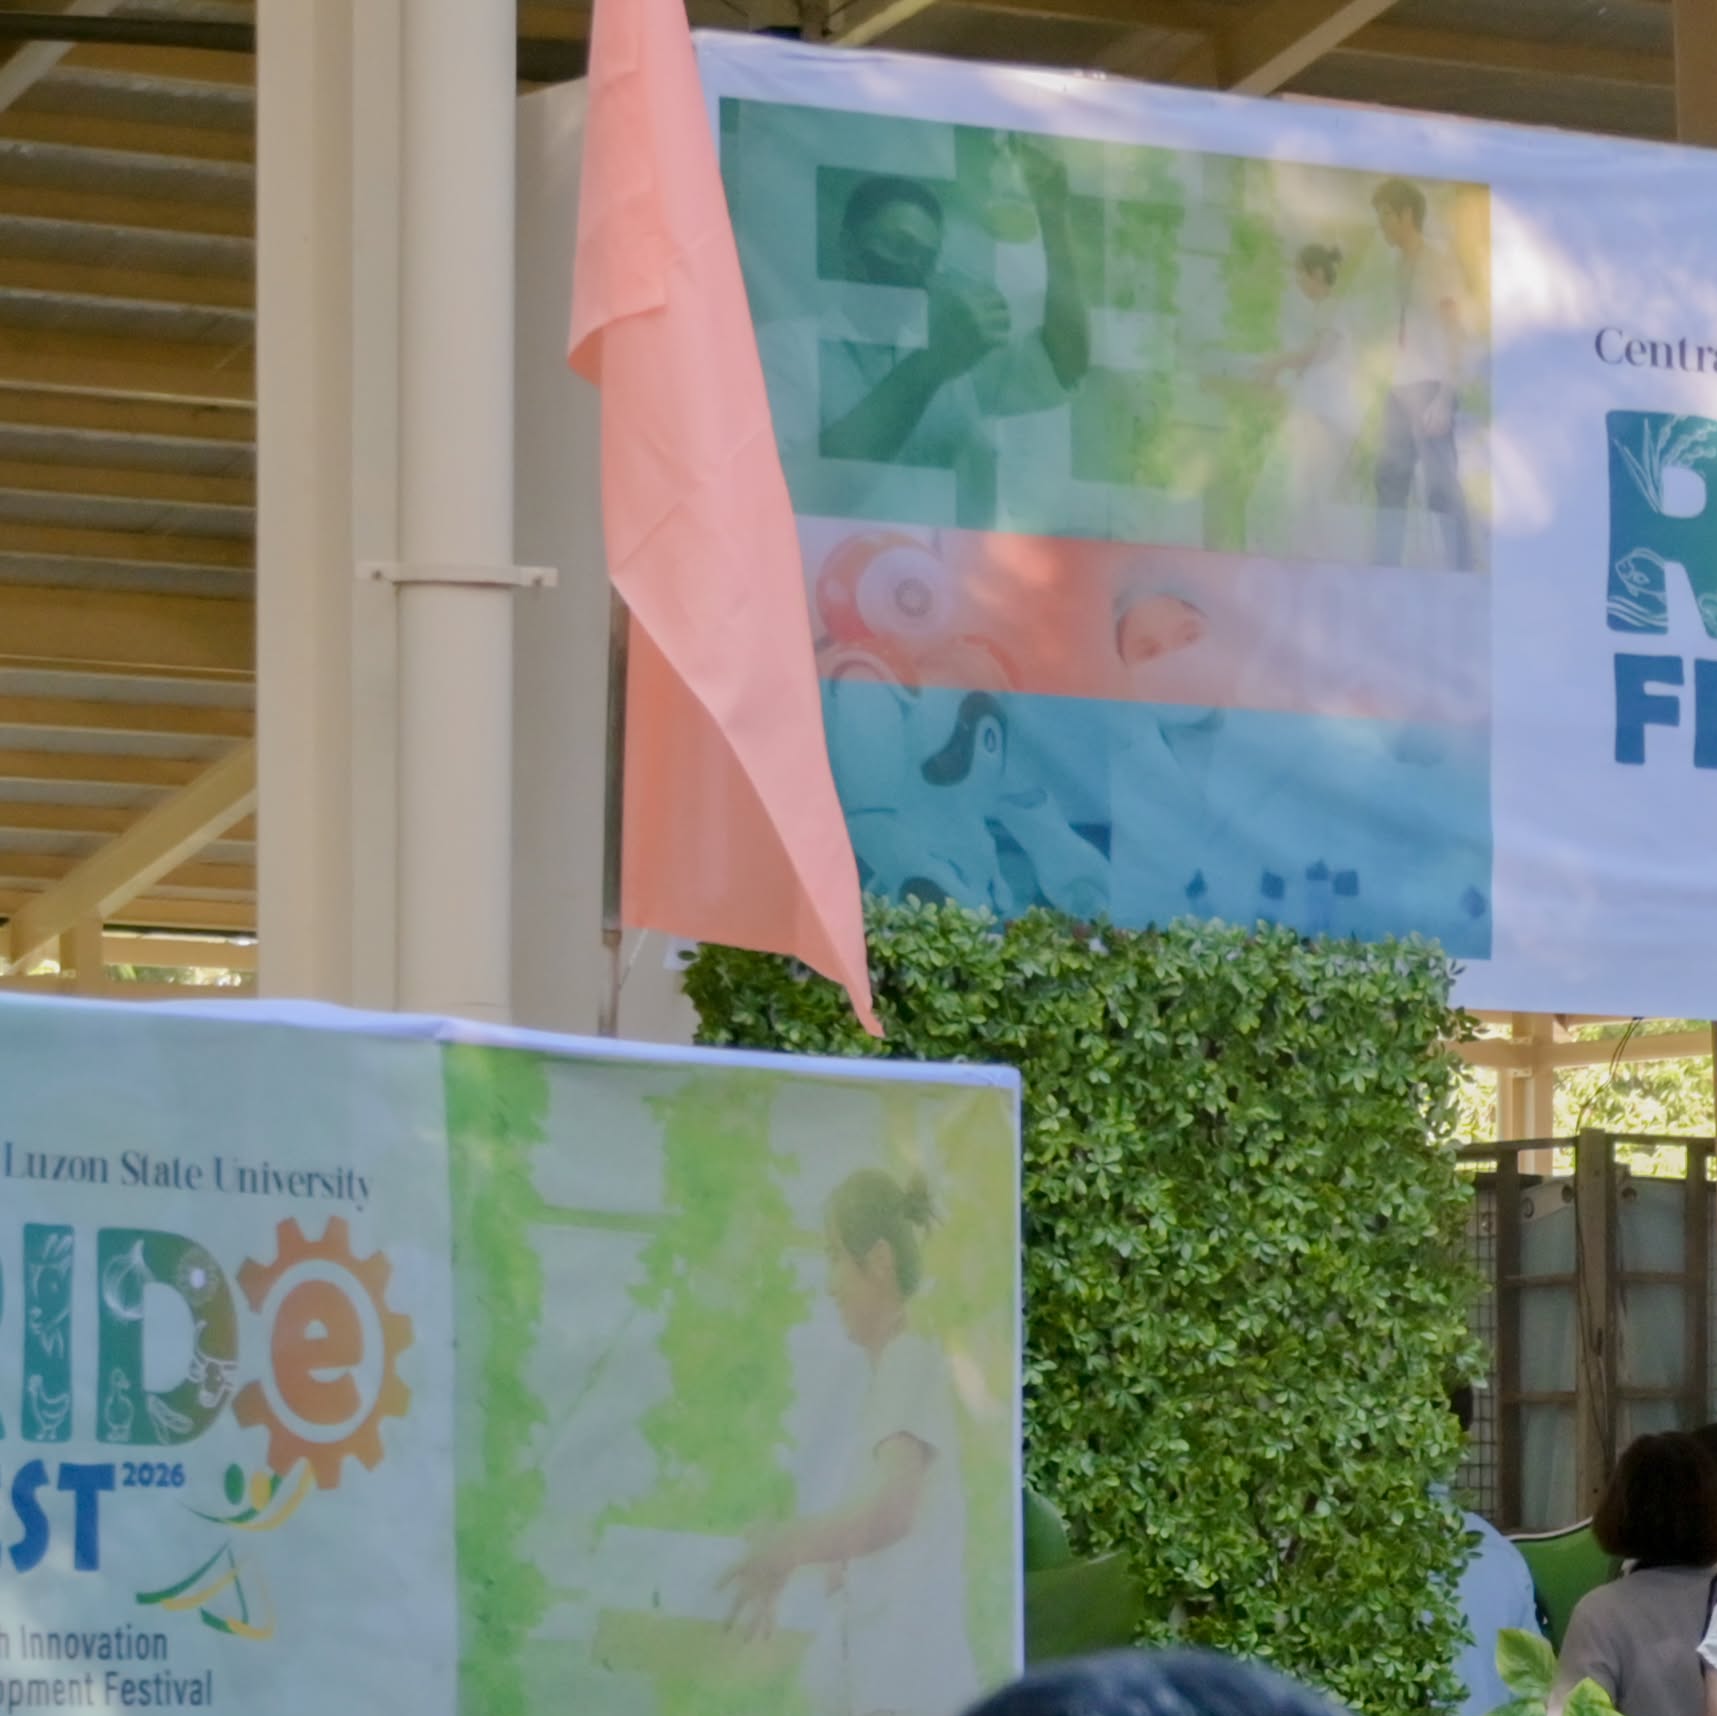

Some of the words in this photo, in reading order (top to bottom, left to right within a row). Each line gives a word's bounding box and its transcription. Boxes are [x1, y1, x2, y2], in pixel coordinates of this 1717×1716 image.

[4, 1142, 109, 1184] Luzon
[120, 1150, 203, 1191] State
[212, 1156, 372, 1212] University
[0, 1222, 365, 1446] IDe
[0, 1458, 116, 1574] ST
[122, 1461, 186, 1488] 2026
[21, 1623, 168, 1661] Innovation
[105, 1669, 213, 1707] Festival
